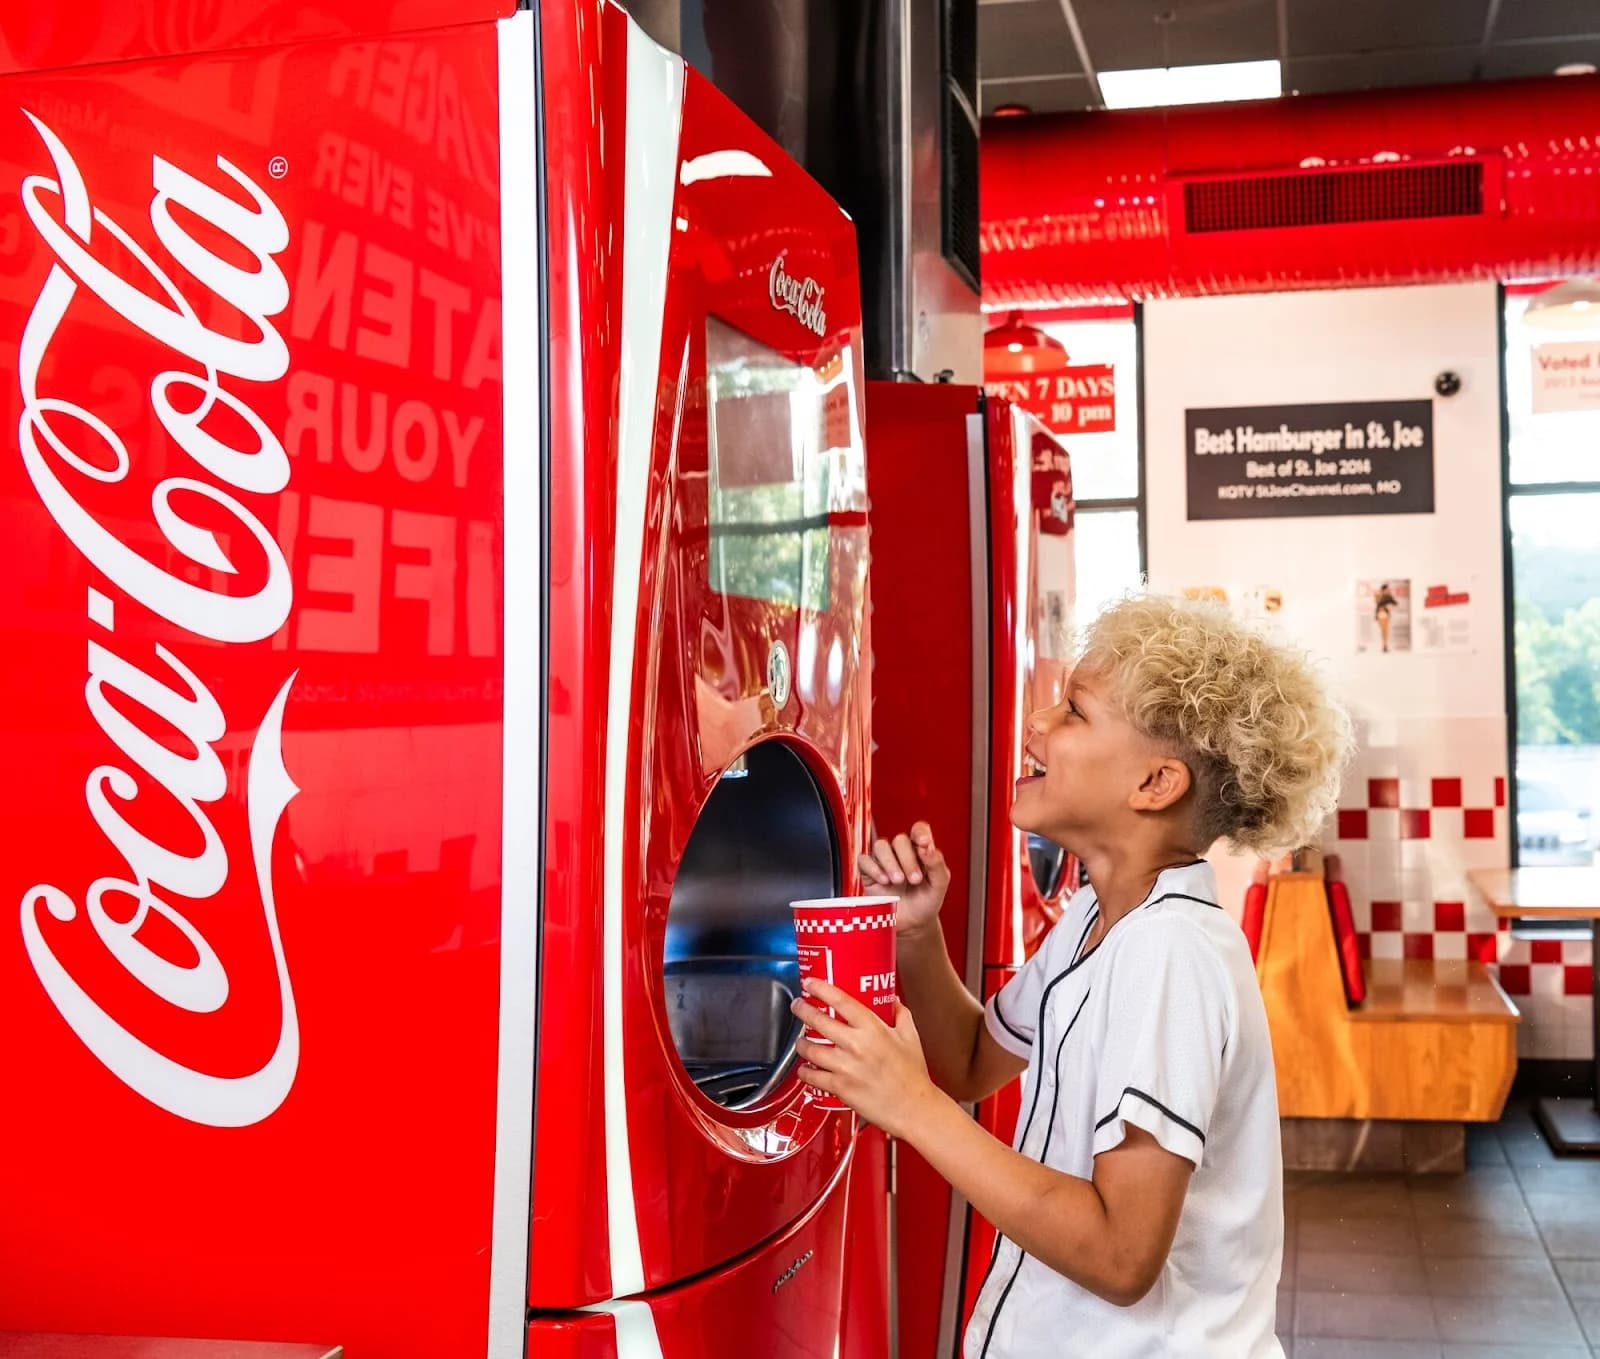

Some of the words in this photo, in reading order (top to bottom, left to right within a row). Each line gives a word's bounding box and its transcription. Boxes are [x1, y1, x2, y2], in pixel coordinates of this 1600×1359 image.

[769, 254, 827, 337] Coca-Cola
[1538, 353, 1591, 371] Voted
[1035, 377, 1050, 401] 7
[1055, 375, 1115, 400] DAYS
[1051, 402, 1072, 423] 10
[1077, 404, 1112, 427] pm
[1194, 428, 1235, 454] Best
[1236, 424, 1343, 455] Hamburger
[1345, 422, 1364, 449] in
[1367, 420, 1391, 449] St.
[1393, 420, 1424, 450] Joe
[1246, 460, 1276, 478] Best
[1277, 460, 1293, 477] of
[1295, 459, 1313, 477] St.
[1315, 459, 1338, 477] Joe
[1377, 480, 1401, 495] MO
[19, 107, 301, 1128] Coca-Cola
[860, 971, 896, 993] FIVE
